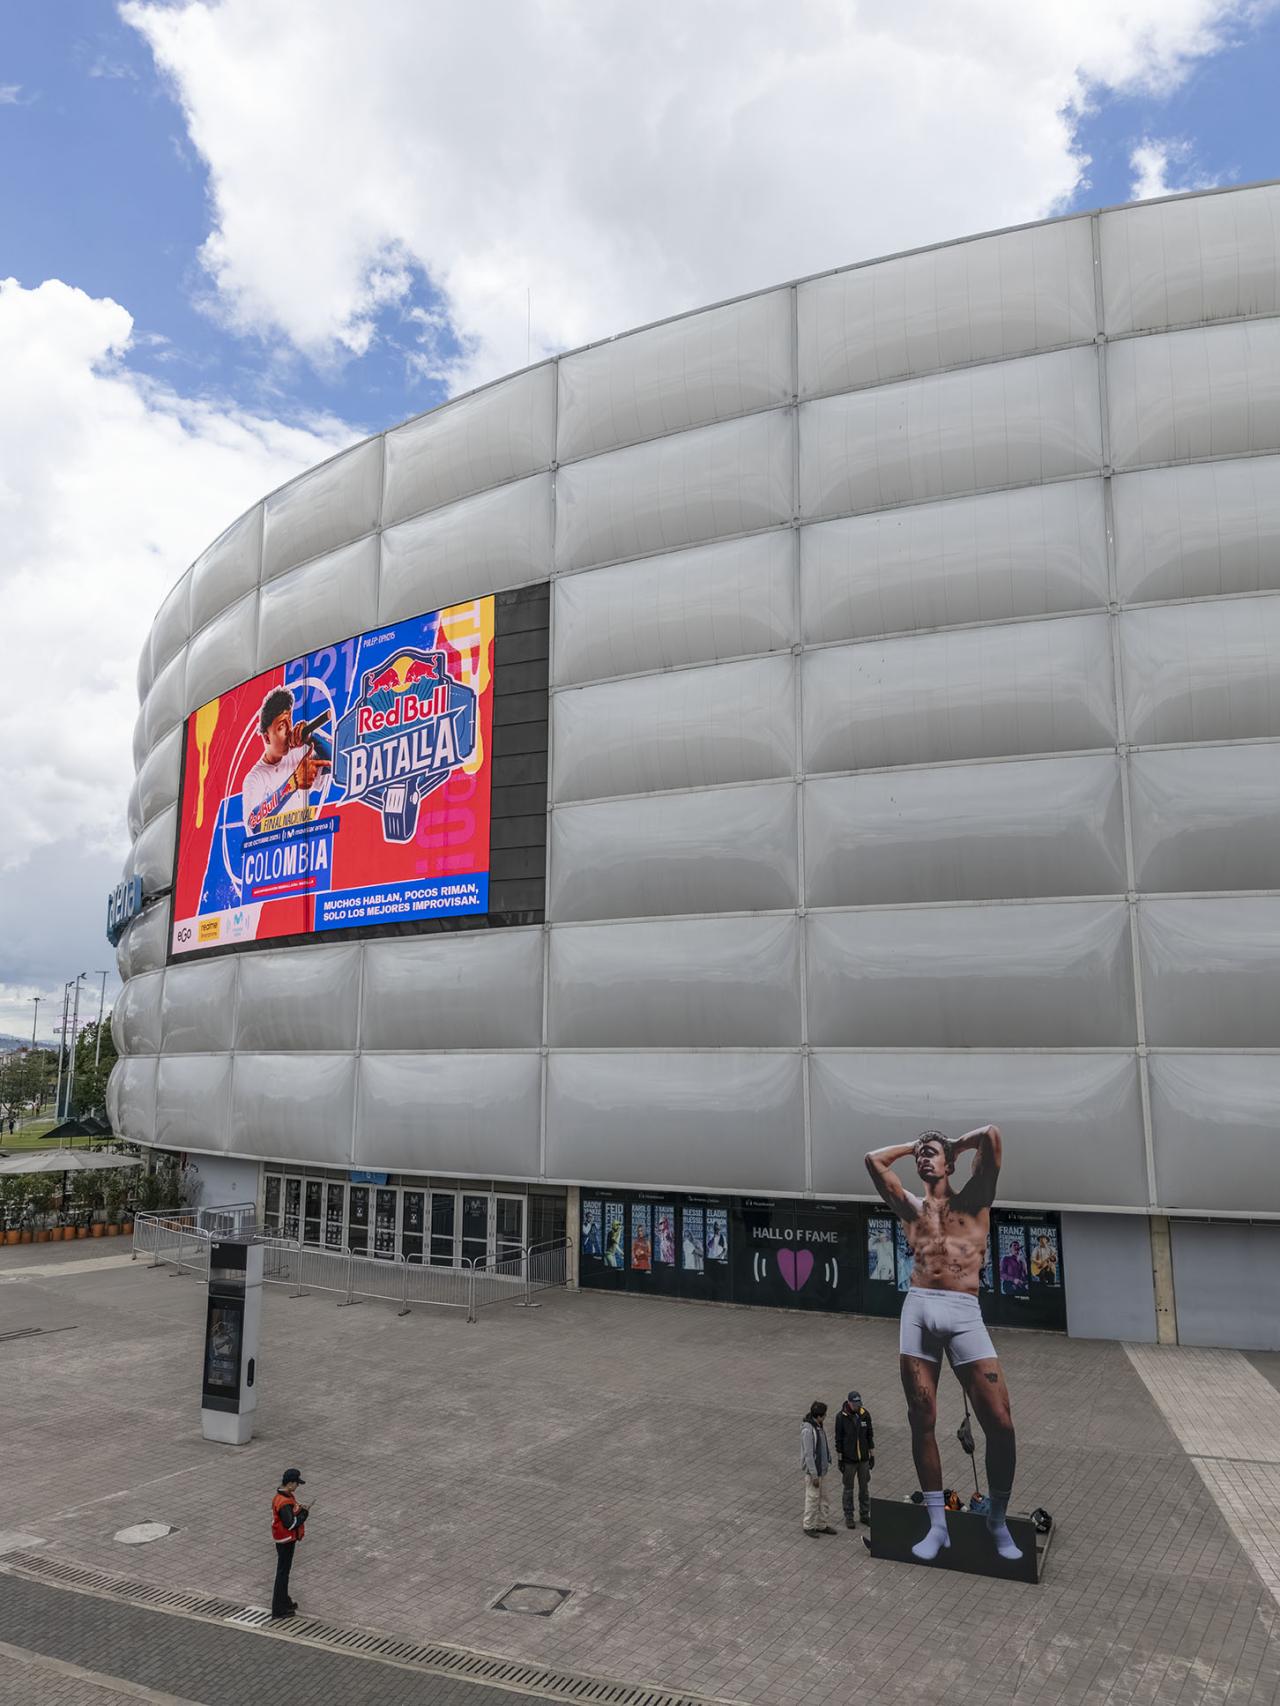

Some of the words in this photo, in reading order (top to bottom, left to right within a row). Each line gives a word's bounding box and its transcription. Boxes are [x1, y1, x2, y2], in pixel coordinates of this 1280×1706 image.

[358, 697, 402, 735] Red
[402, 684, 448, 723] Bull
[350, 716, 456, 796] BATALLA
[261, 792, 278, 817] Bull
[245, 838, 328, 885] COLOMBIA
[323, 898, 361, 910] MUCHOS
[362, 892, 402, 904] HABLAN,
[404, 887, 438, 900] POCOS
[440, 883, 479, 896] RIMAN,
[323, 909, 346, 921] SOLO
[347, 908, 365, 919] LOS
[366, 903, 410, 916] MEJORES
[412, 895, 480, 911] IMPROVISAN.
[606, 1203, 624, 1214] FEID
[753, 1227, 783, 1240] HALL
[805, 1230, 839, 1243] FAME
[868, 1219, 892, 1229] WISIN
[999, 1226, 1024, 1236] FRANZ
[1030, 1228, 1057, 1238] MORAT
